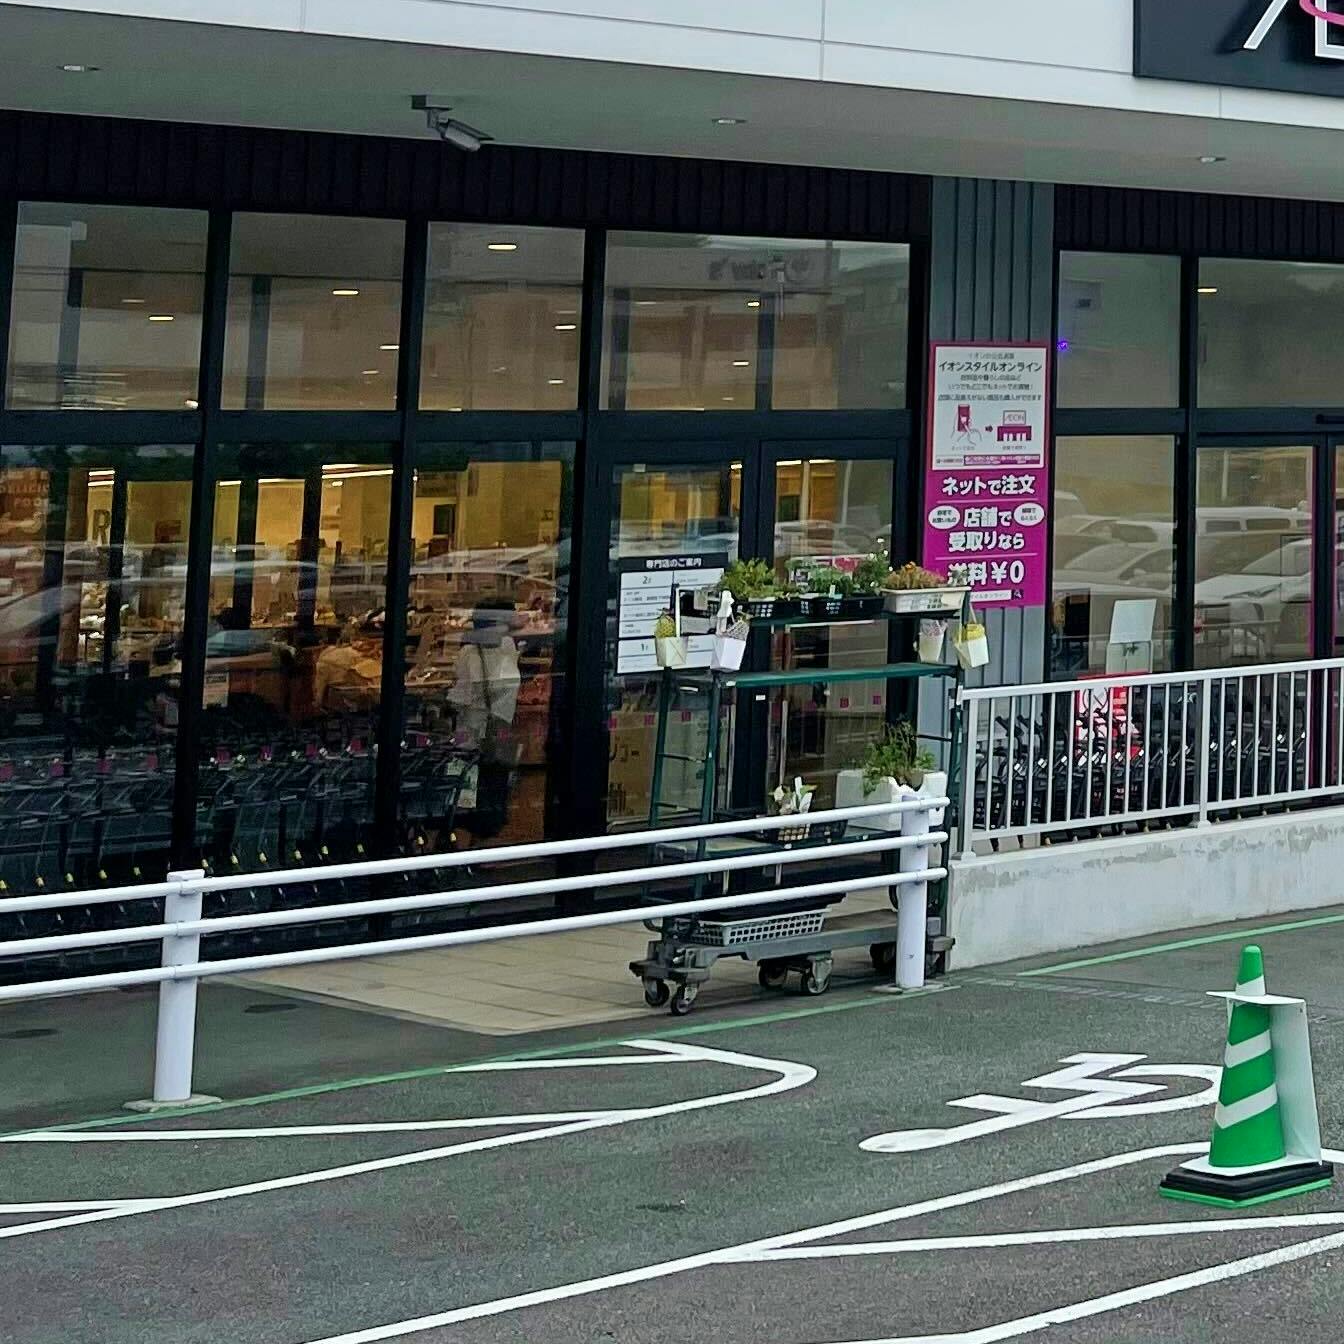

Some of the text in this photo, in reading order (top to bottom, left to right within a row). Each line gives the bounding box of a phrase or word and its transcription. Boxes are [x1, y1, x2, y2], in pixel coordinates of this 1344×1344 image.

[938, 361, 1043, 373] イオンスタイルオンライン
[942, 474, 1036, 496] ネットで注文
[963, 506, 1012, 528] 店舗で
[948, 530, 1025, 552] 受取りなら
